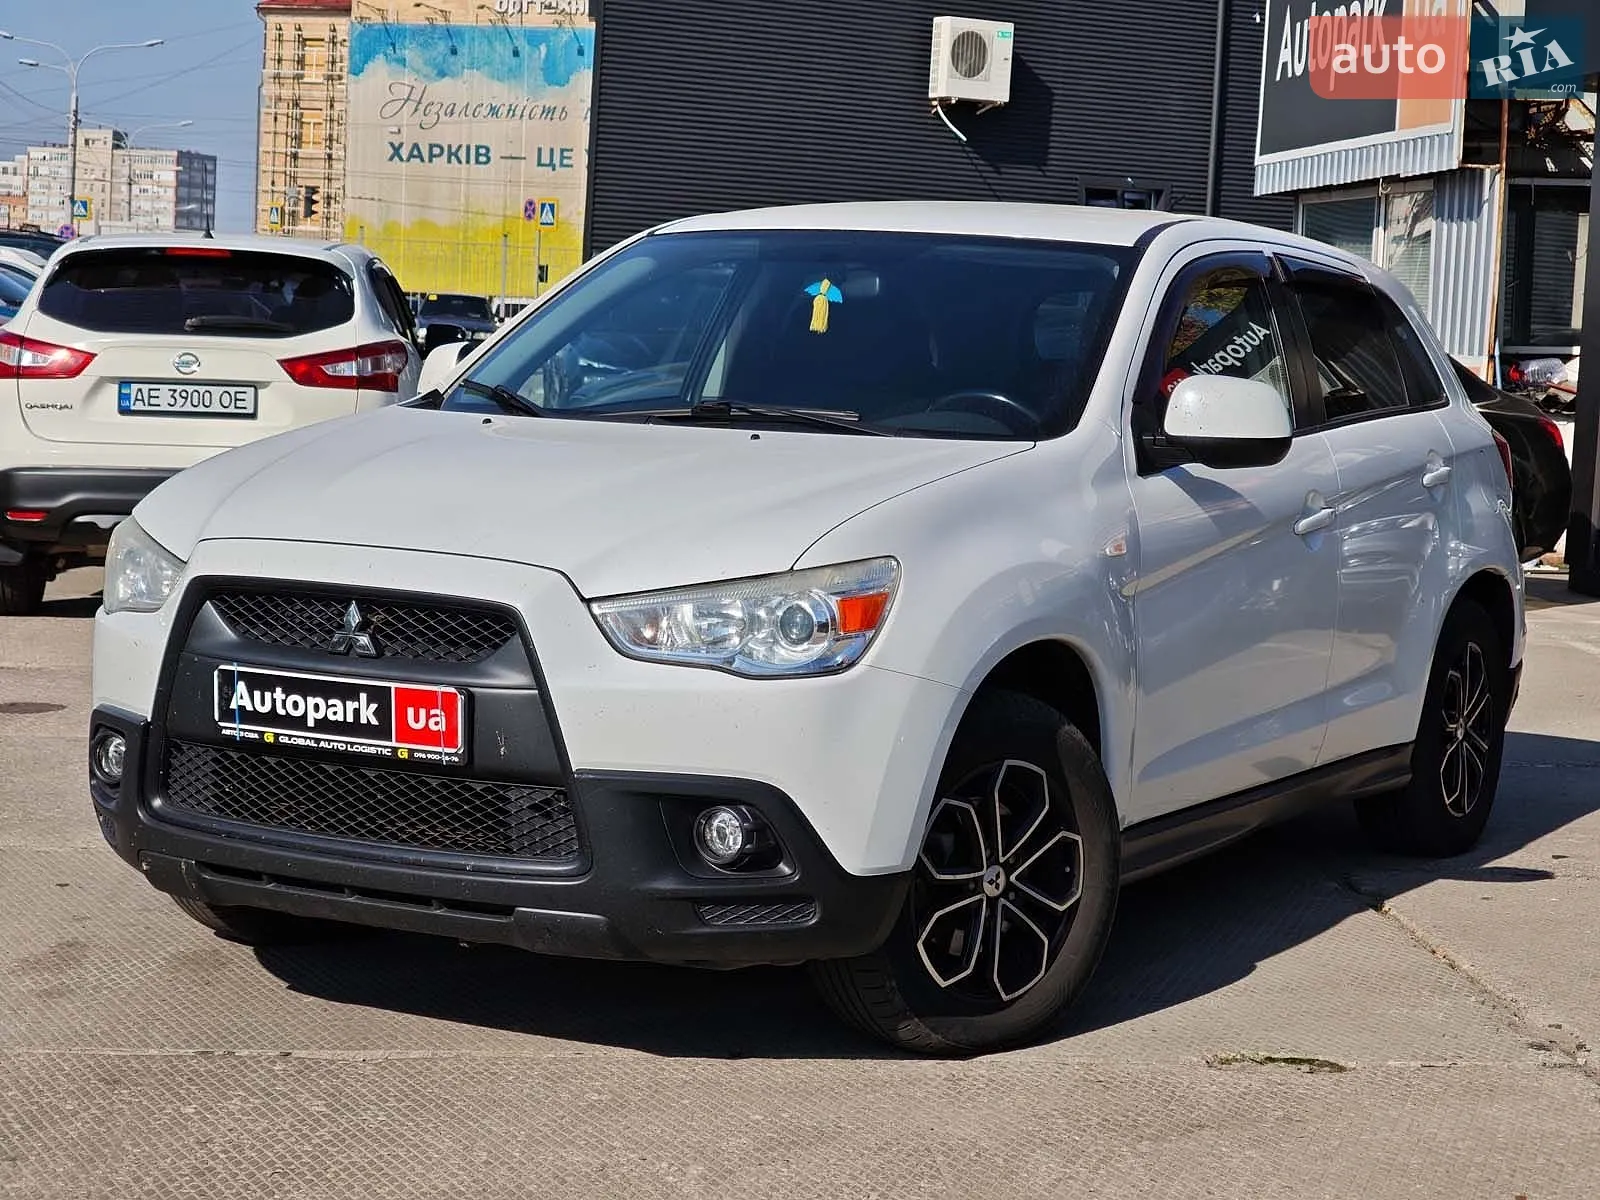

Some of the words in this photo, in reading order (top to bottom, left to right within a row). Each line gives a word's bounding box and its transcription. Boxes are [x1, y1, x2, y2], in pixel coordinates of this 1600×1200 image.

[379, 82, 568, 130] Незалежність
[387, 141, 492, 166] ХАРКІВ
[536, 147, 574, 172] ЦЕ
[133, 388, 161, 407] AE
[167, 388, 212, 409] 3900
[219, 390, 248, 410] OE
[229, 680, 380, 728] Autopark
[406, 706, 447, 732] ua
[278, 736, 318, 748] GLOBAL
[319, 741, 346, 751] AUTO
[347, 745, 392, 756] LOGISTIC
